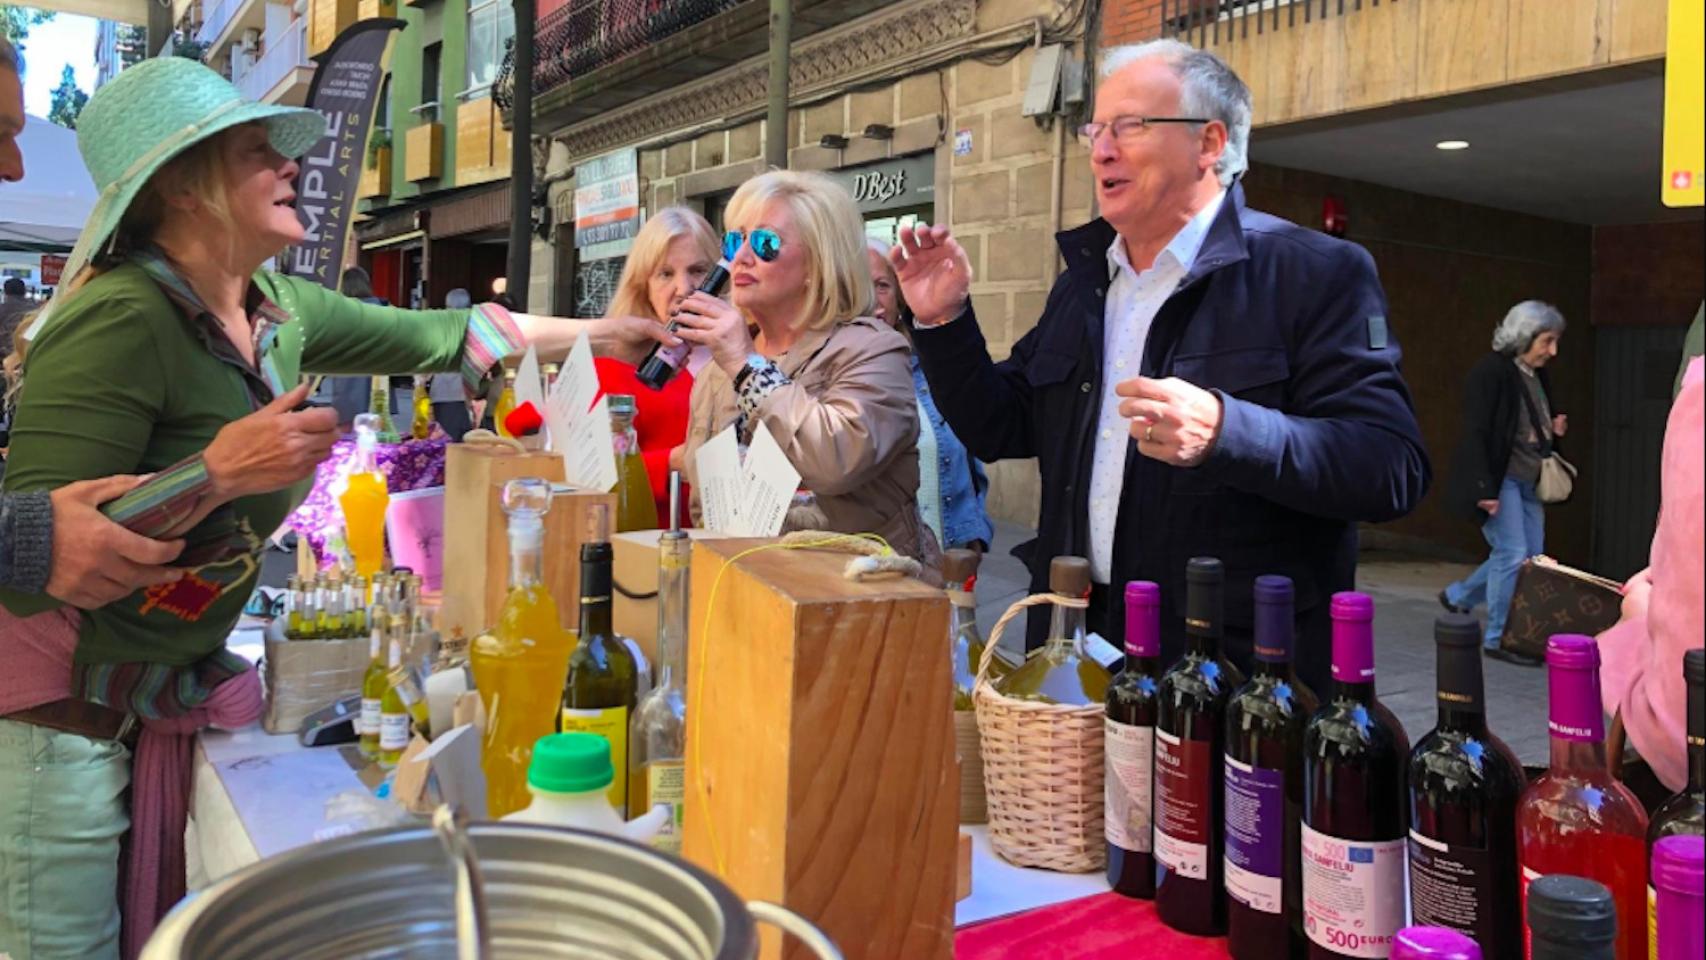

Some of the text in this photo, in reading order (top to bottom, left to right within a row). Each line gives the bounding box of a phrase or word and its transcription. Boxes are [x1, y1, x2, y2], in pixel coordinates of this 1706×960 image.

[294, 110, 344, 275] EMPLE
[317, 190, 344, 278] ARTIAL
[338, 113, 360, 177] ARTS
[1325, 925, 1393, 951] 500 EURO
